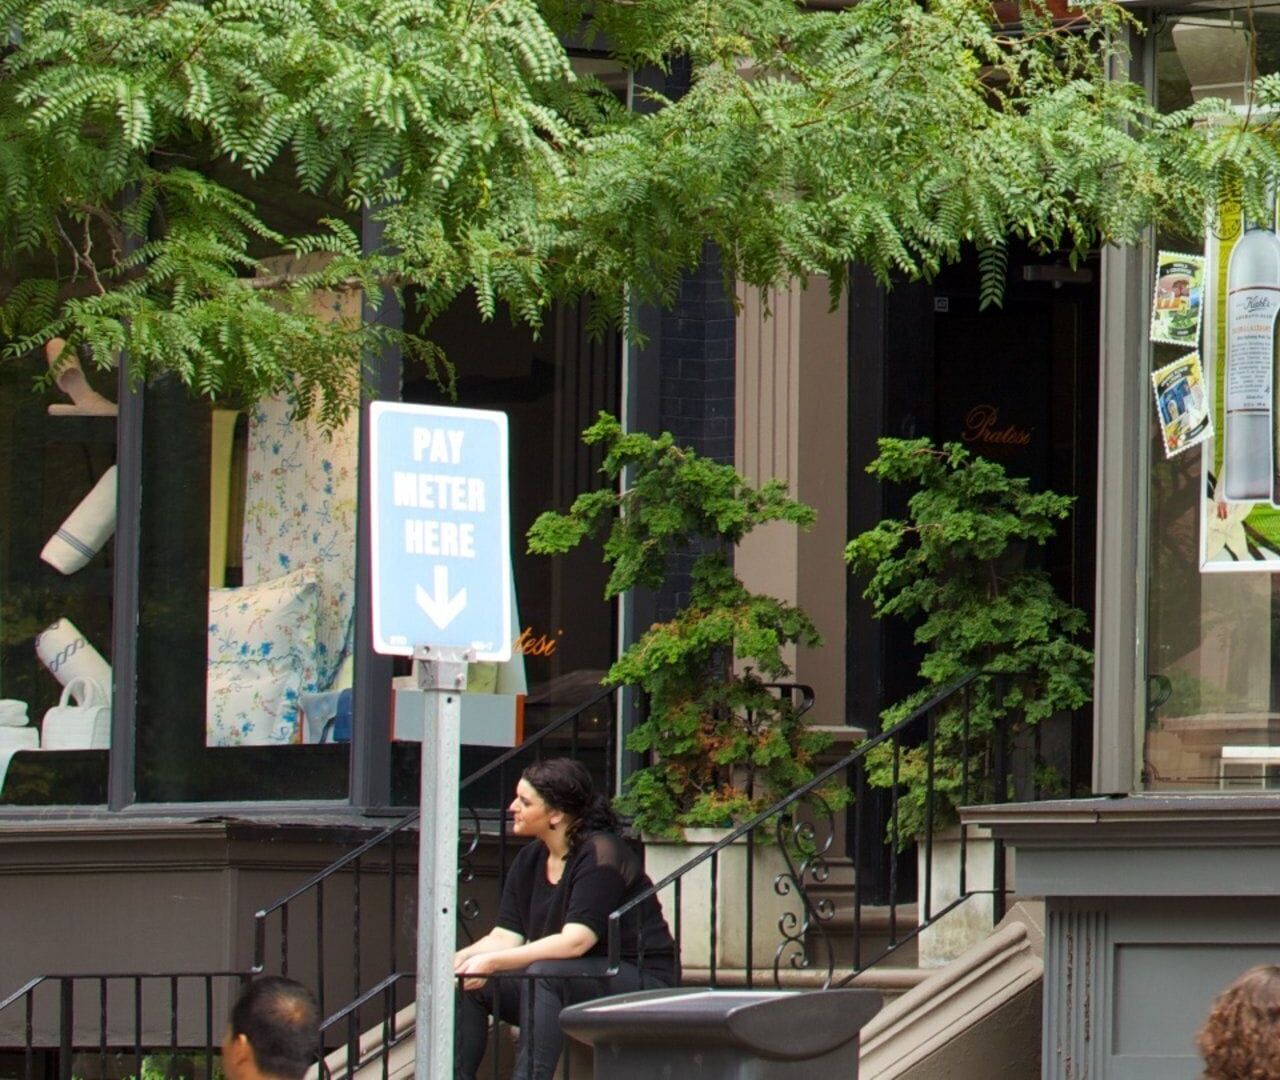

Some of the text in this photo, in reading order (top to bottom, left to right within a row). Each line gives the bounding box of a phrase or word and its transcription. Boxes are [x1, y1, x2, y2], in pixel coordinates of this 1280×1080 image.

[413, 426, 465, 465] PAY
[393, 471, 486, 513] METER
[405, 519, 476, 559] HERE
[512, 626, 563, 656] tesi
